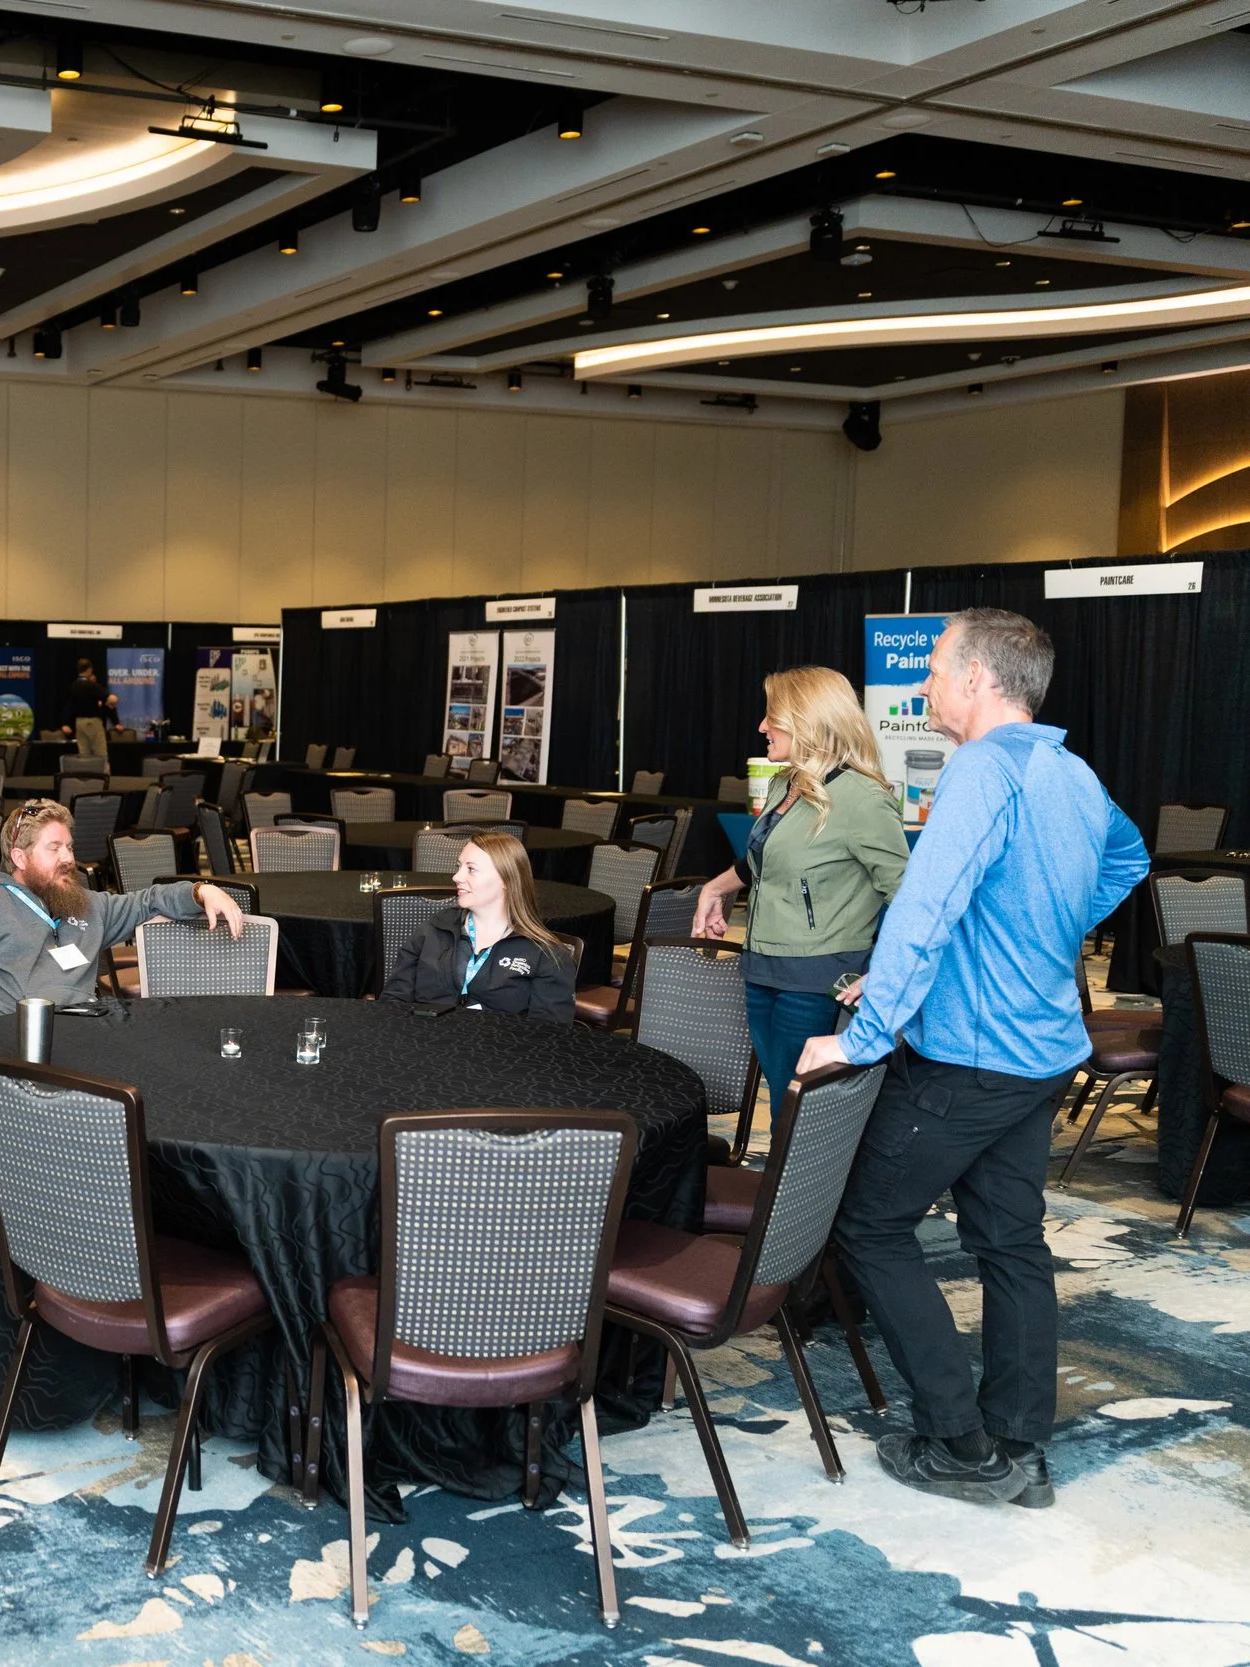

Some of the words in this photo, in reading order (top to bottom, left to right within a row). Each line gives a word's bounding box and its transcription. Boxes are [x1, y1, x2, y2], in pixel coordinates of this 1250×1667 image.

[1100, 575, 1134, 585] PAINTCARE
[1188, 582, 1196, 590] 26
[709, 594, 732, 603] MINNESOTA
[733, 594, 752, 602] BEVERAGE
[754, 593, 782, 602] ASSOCIATION
[874, 630, 927, 650] Recycle
